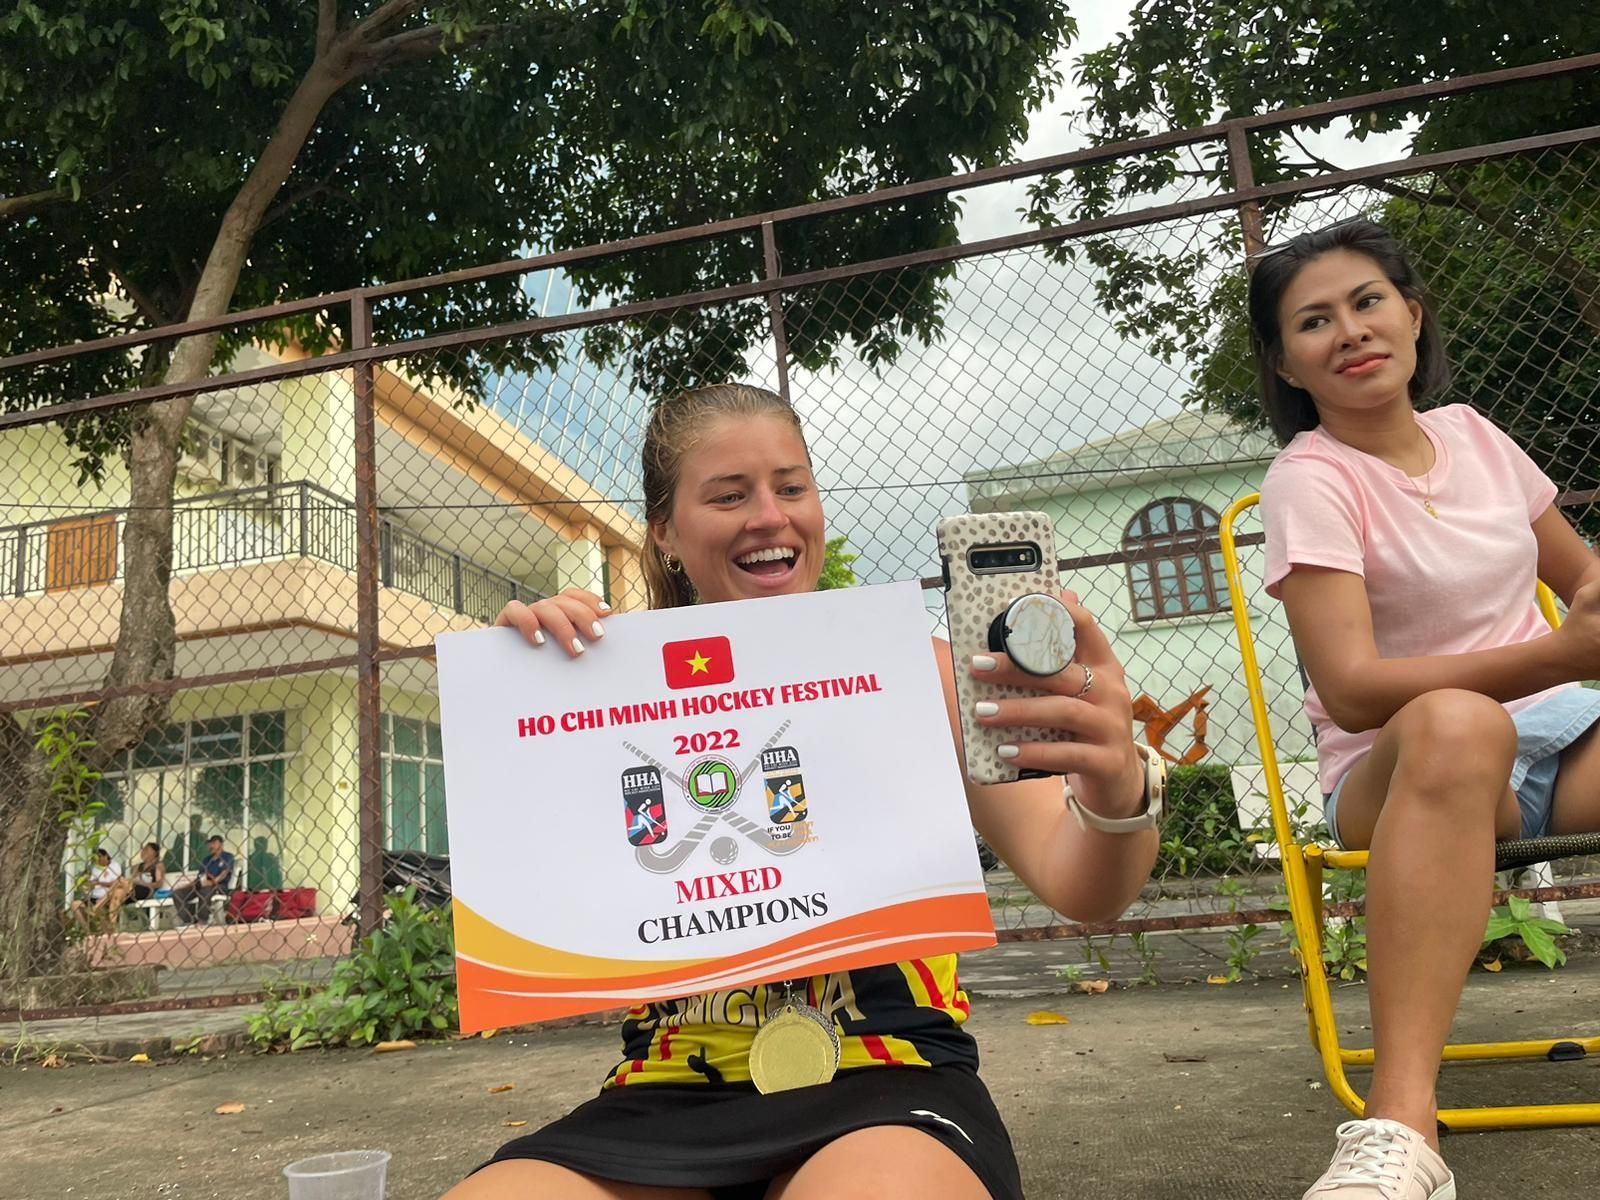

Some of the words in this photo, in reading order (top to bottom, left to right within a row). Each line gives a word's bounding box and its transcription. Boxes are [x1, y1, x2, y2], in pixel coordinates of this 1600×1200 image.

[517, 715, 556, 738] HO
[560, 709, 604, 733] CHI
[609, 700, 677, 726] MINH
[682, 687, 775, 717] HOCKEY
[780, 674, 882, 704] FESTIVAL
[673, 728, 741, 755] 2022
[763, 749, 797, 764] HHA
[623, 772, 660, 788] HHA
[674, 866, 783, 904] MIXED
[637, 892, 829, 944] CHAMPIONS
